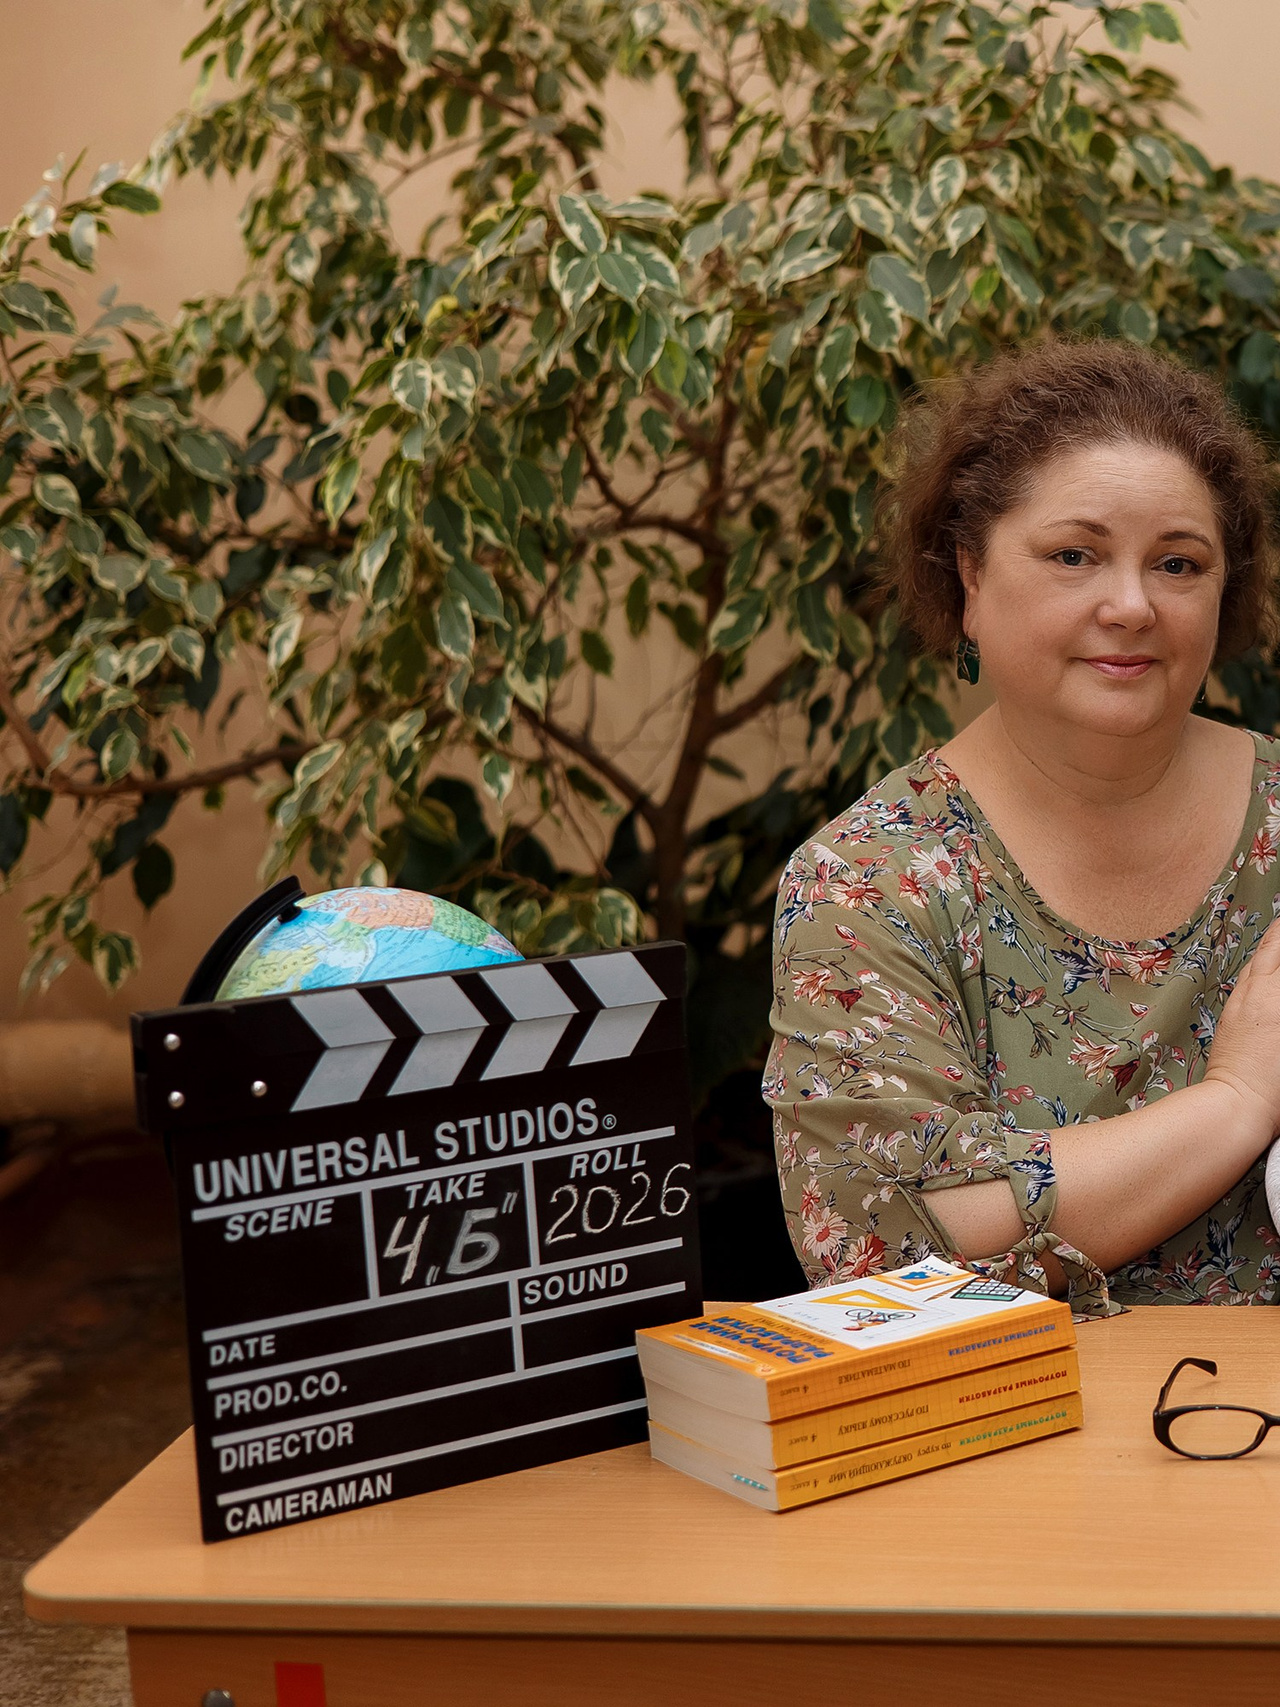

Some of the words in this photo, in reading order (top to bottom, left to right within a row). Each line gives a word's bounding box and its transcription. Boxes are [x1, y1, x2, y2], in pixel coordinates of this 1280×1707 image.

[193, 1130, 420, 1204] UNIVERSAL
[569, 1143, 647, 1179] ROLL
[405, 1172, 486, 1209] TAKE
[546, 1163, 691, 1245] 2026
[224, 1199, 333, 1242] SCENE
[523, 1262, 628, 1305] SOUND
[689, 1321, 812, 1364] ПОУРОЧНЫЕ
[712, 1315, 835, 1359] РАЗРАБОТКИ
[1004, 1323, 1056, 1342] ПОУРОЧНЫЕ
[210, 1335, 276, 1367] DATE
[948, 1338, 1002, 1356] РАЗРАБОТКИ
[838, 1362, 896, 1385] МАТЕМАТИКЕ
[897, 1358, 911, 1369] ПО
[1015, 1370, 1067, 1389] ПОУРОЧНЫЕ
[214, 1370, 347, 1420] PROD.CO.
[958, 1383, 1013, 1404] РАЗРАБОТКИ
[869, 1408, 915, 1427] РУССКОМУ
[916, 1404, 929, 1415] ПО
[1015, 1411, 1067, 1430] ПОУРОЧНЫЕ
[838, 1420, 868, 1436] ЯЗЫКУ
[959, 1426, 1014, 1446] РАЗРАБОТКИ
[219, 1422, 355, 1474] DIRECTOR
[828, 1471, 848, 1483] МИР
[849, 1452, 913, 1479] ОКРУЖАЮЩИЙ
[224, 1472, 393, 1534] CAMERAMAN
